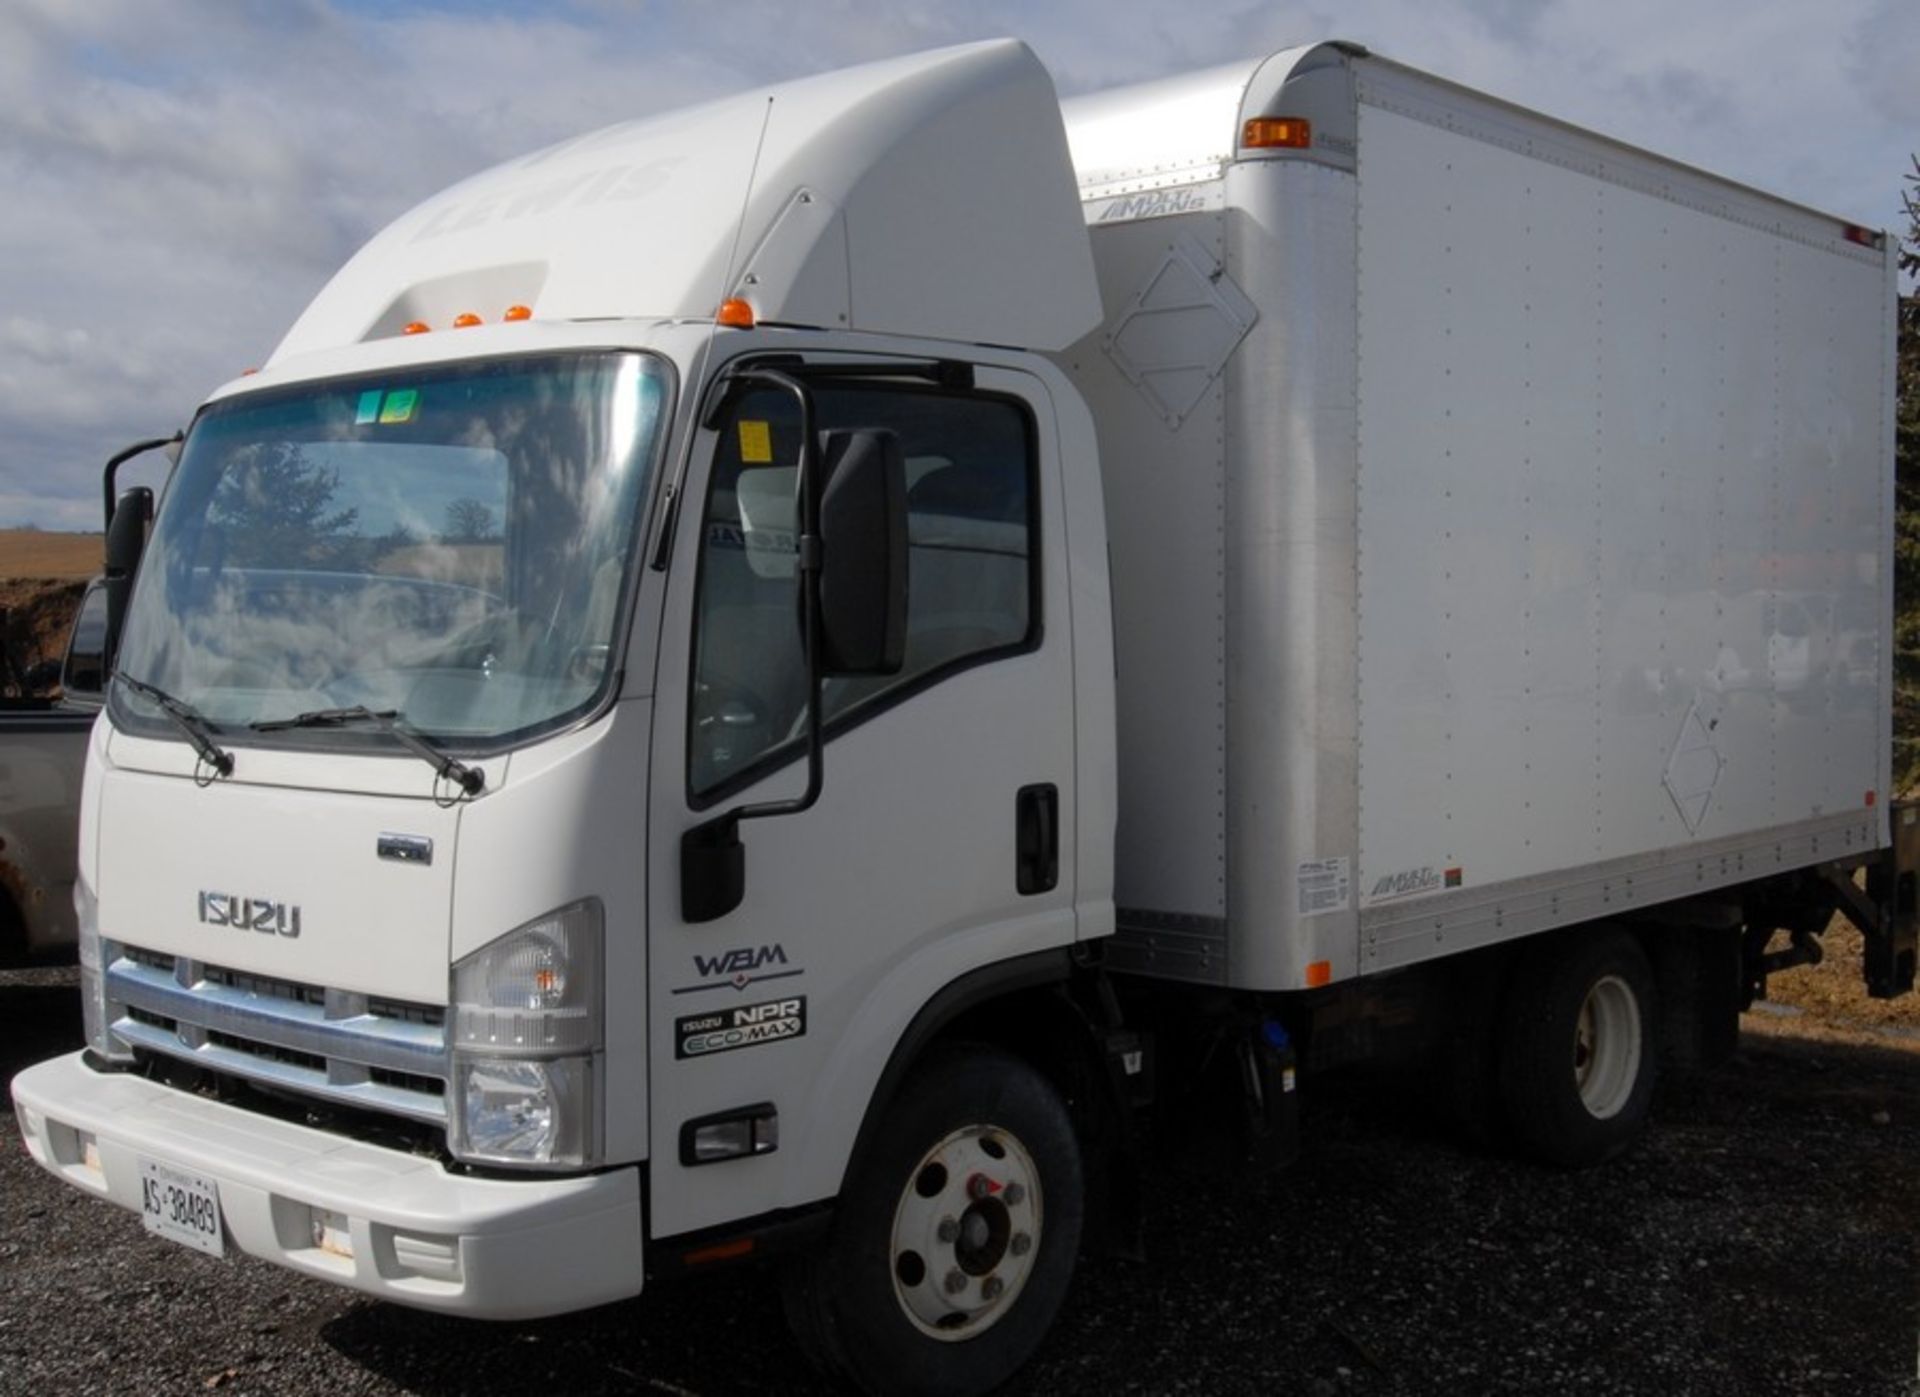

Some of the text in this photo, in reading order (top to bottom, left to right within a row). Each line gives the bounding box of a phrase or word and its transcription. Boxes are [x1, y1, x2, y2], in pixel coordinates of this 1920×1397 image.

[198, 890, 301, 938] ISUZU
[682, 1000, 800, 1032] ISUZU NPR
